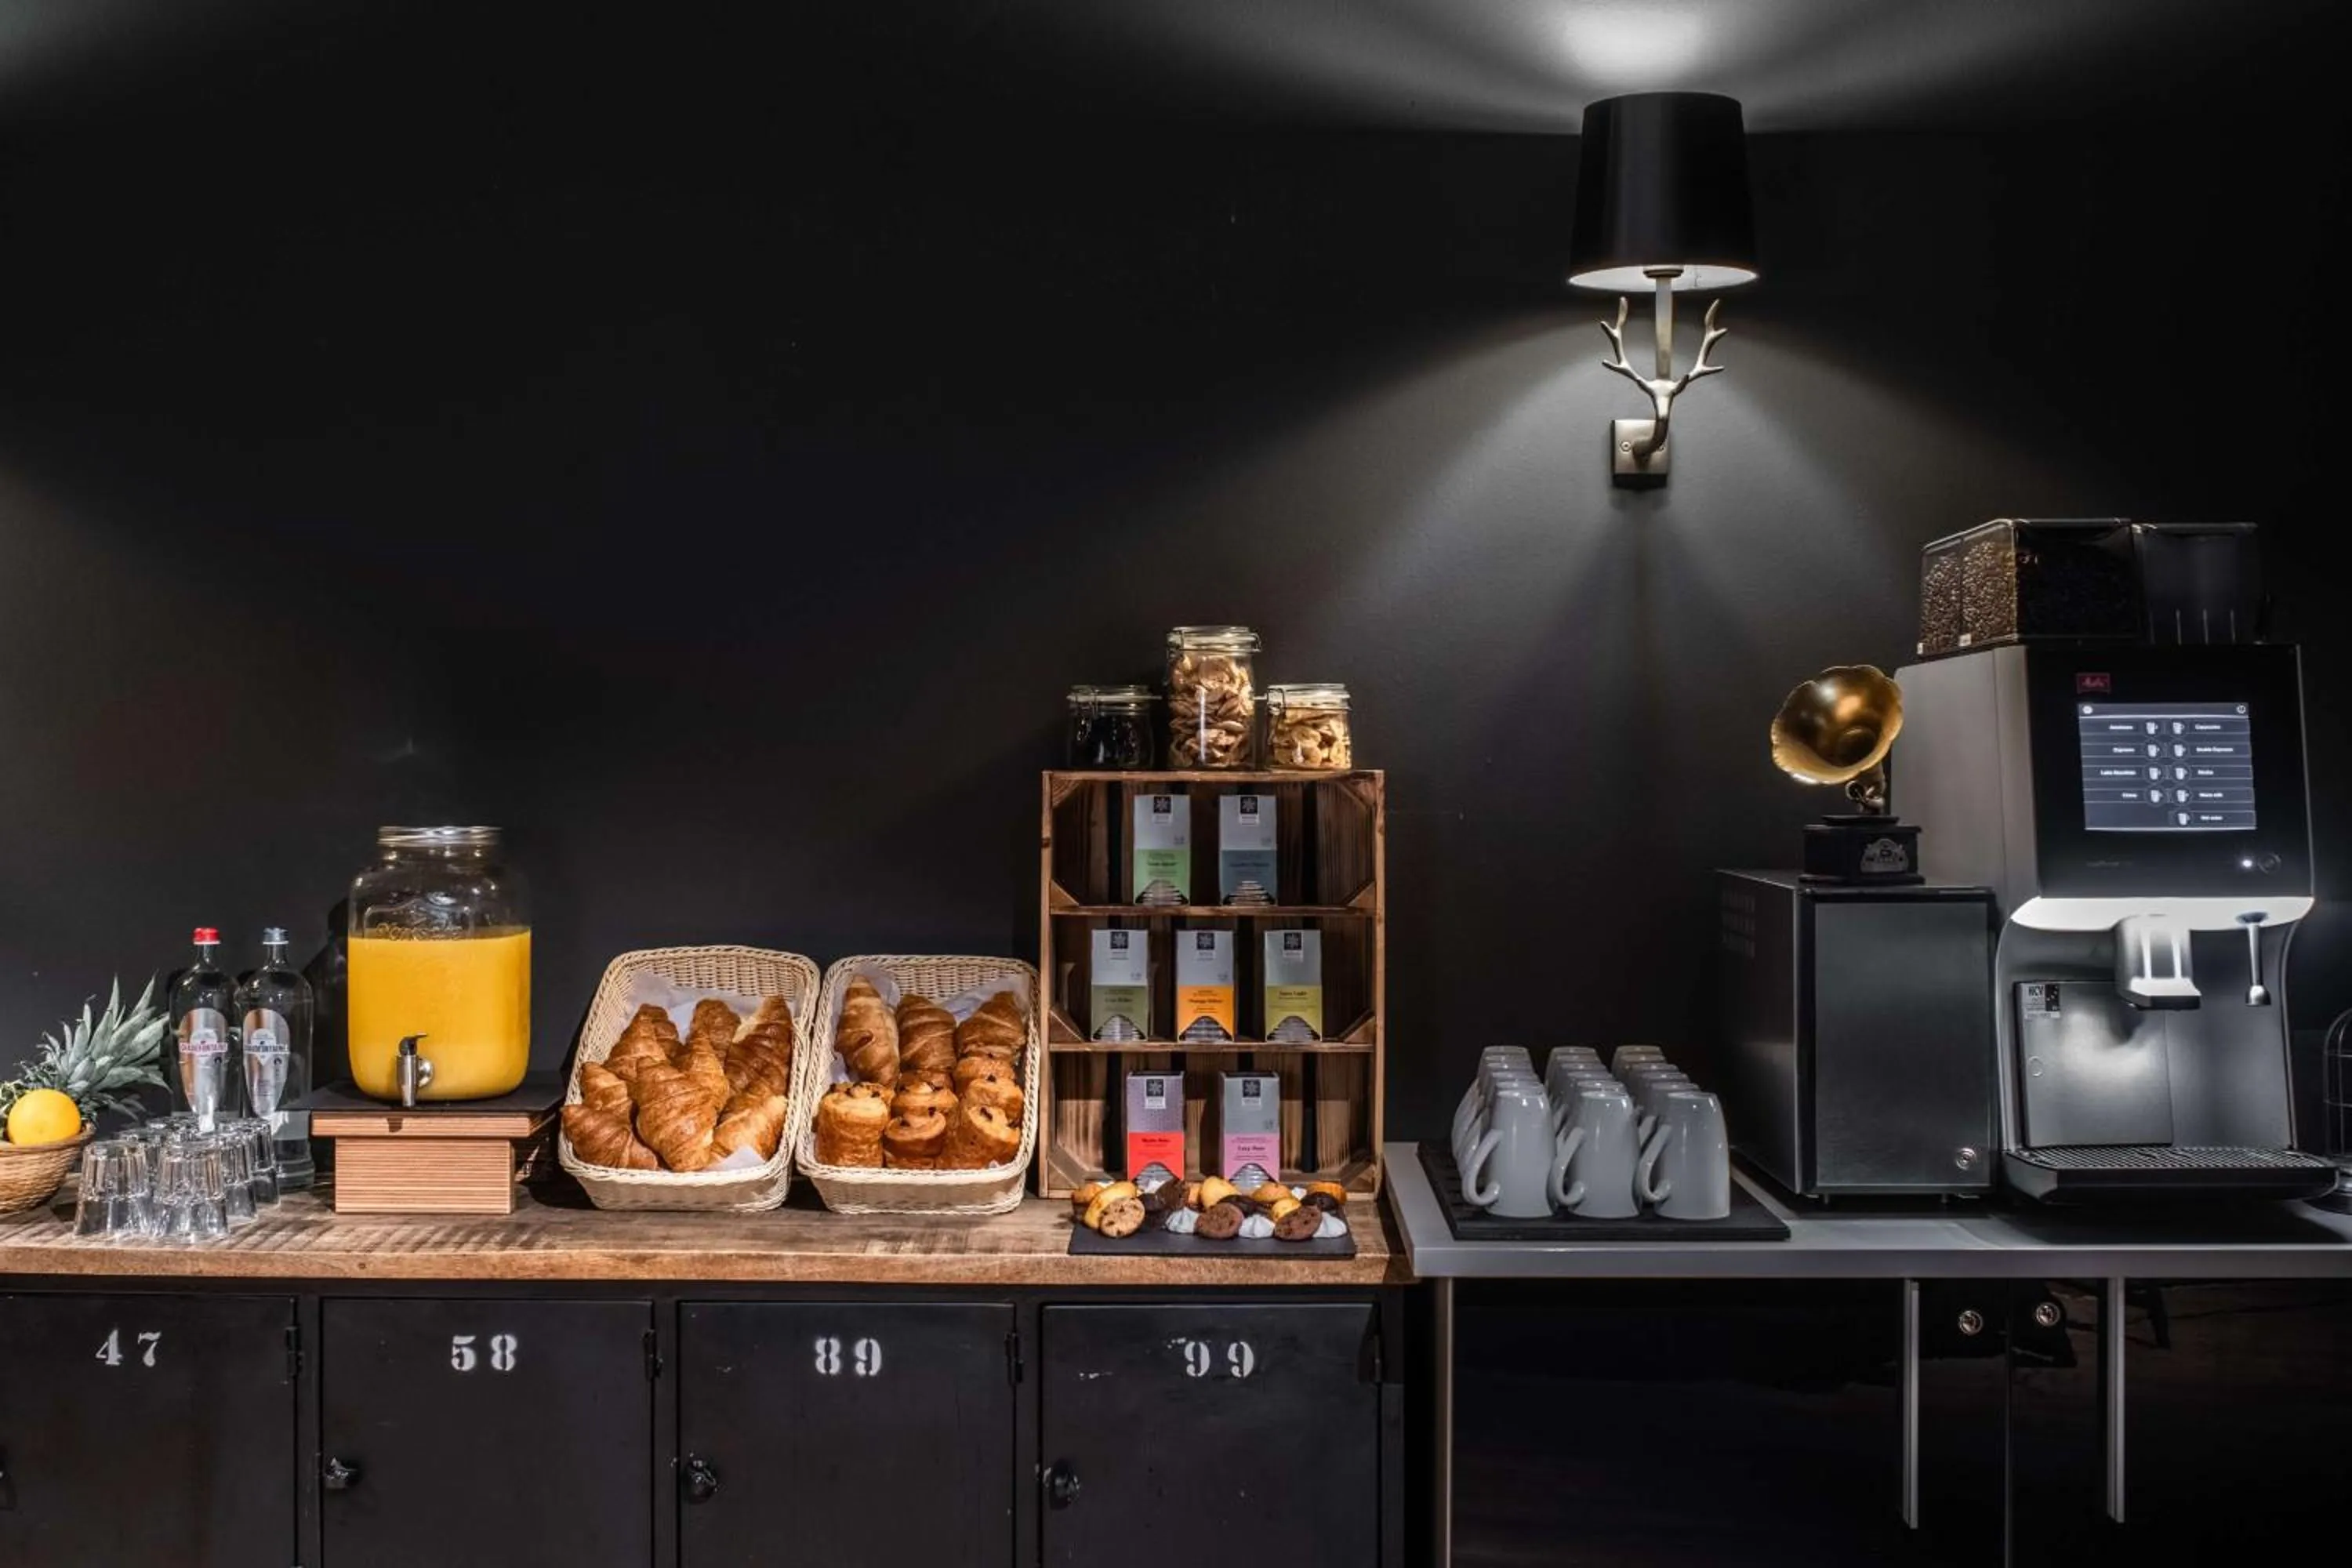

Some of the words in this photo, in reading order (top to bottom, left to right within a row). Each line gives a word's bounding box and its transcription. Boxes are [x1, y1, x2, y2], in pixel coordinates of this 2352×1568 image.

[95, 1329, 162, 1367] 47
[451, 1334, 517, 1371] 58
[815, 1337, 882, 1376] 89
[1185, 1341, 1254, 1377] 99
